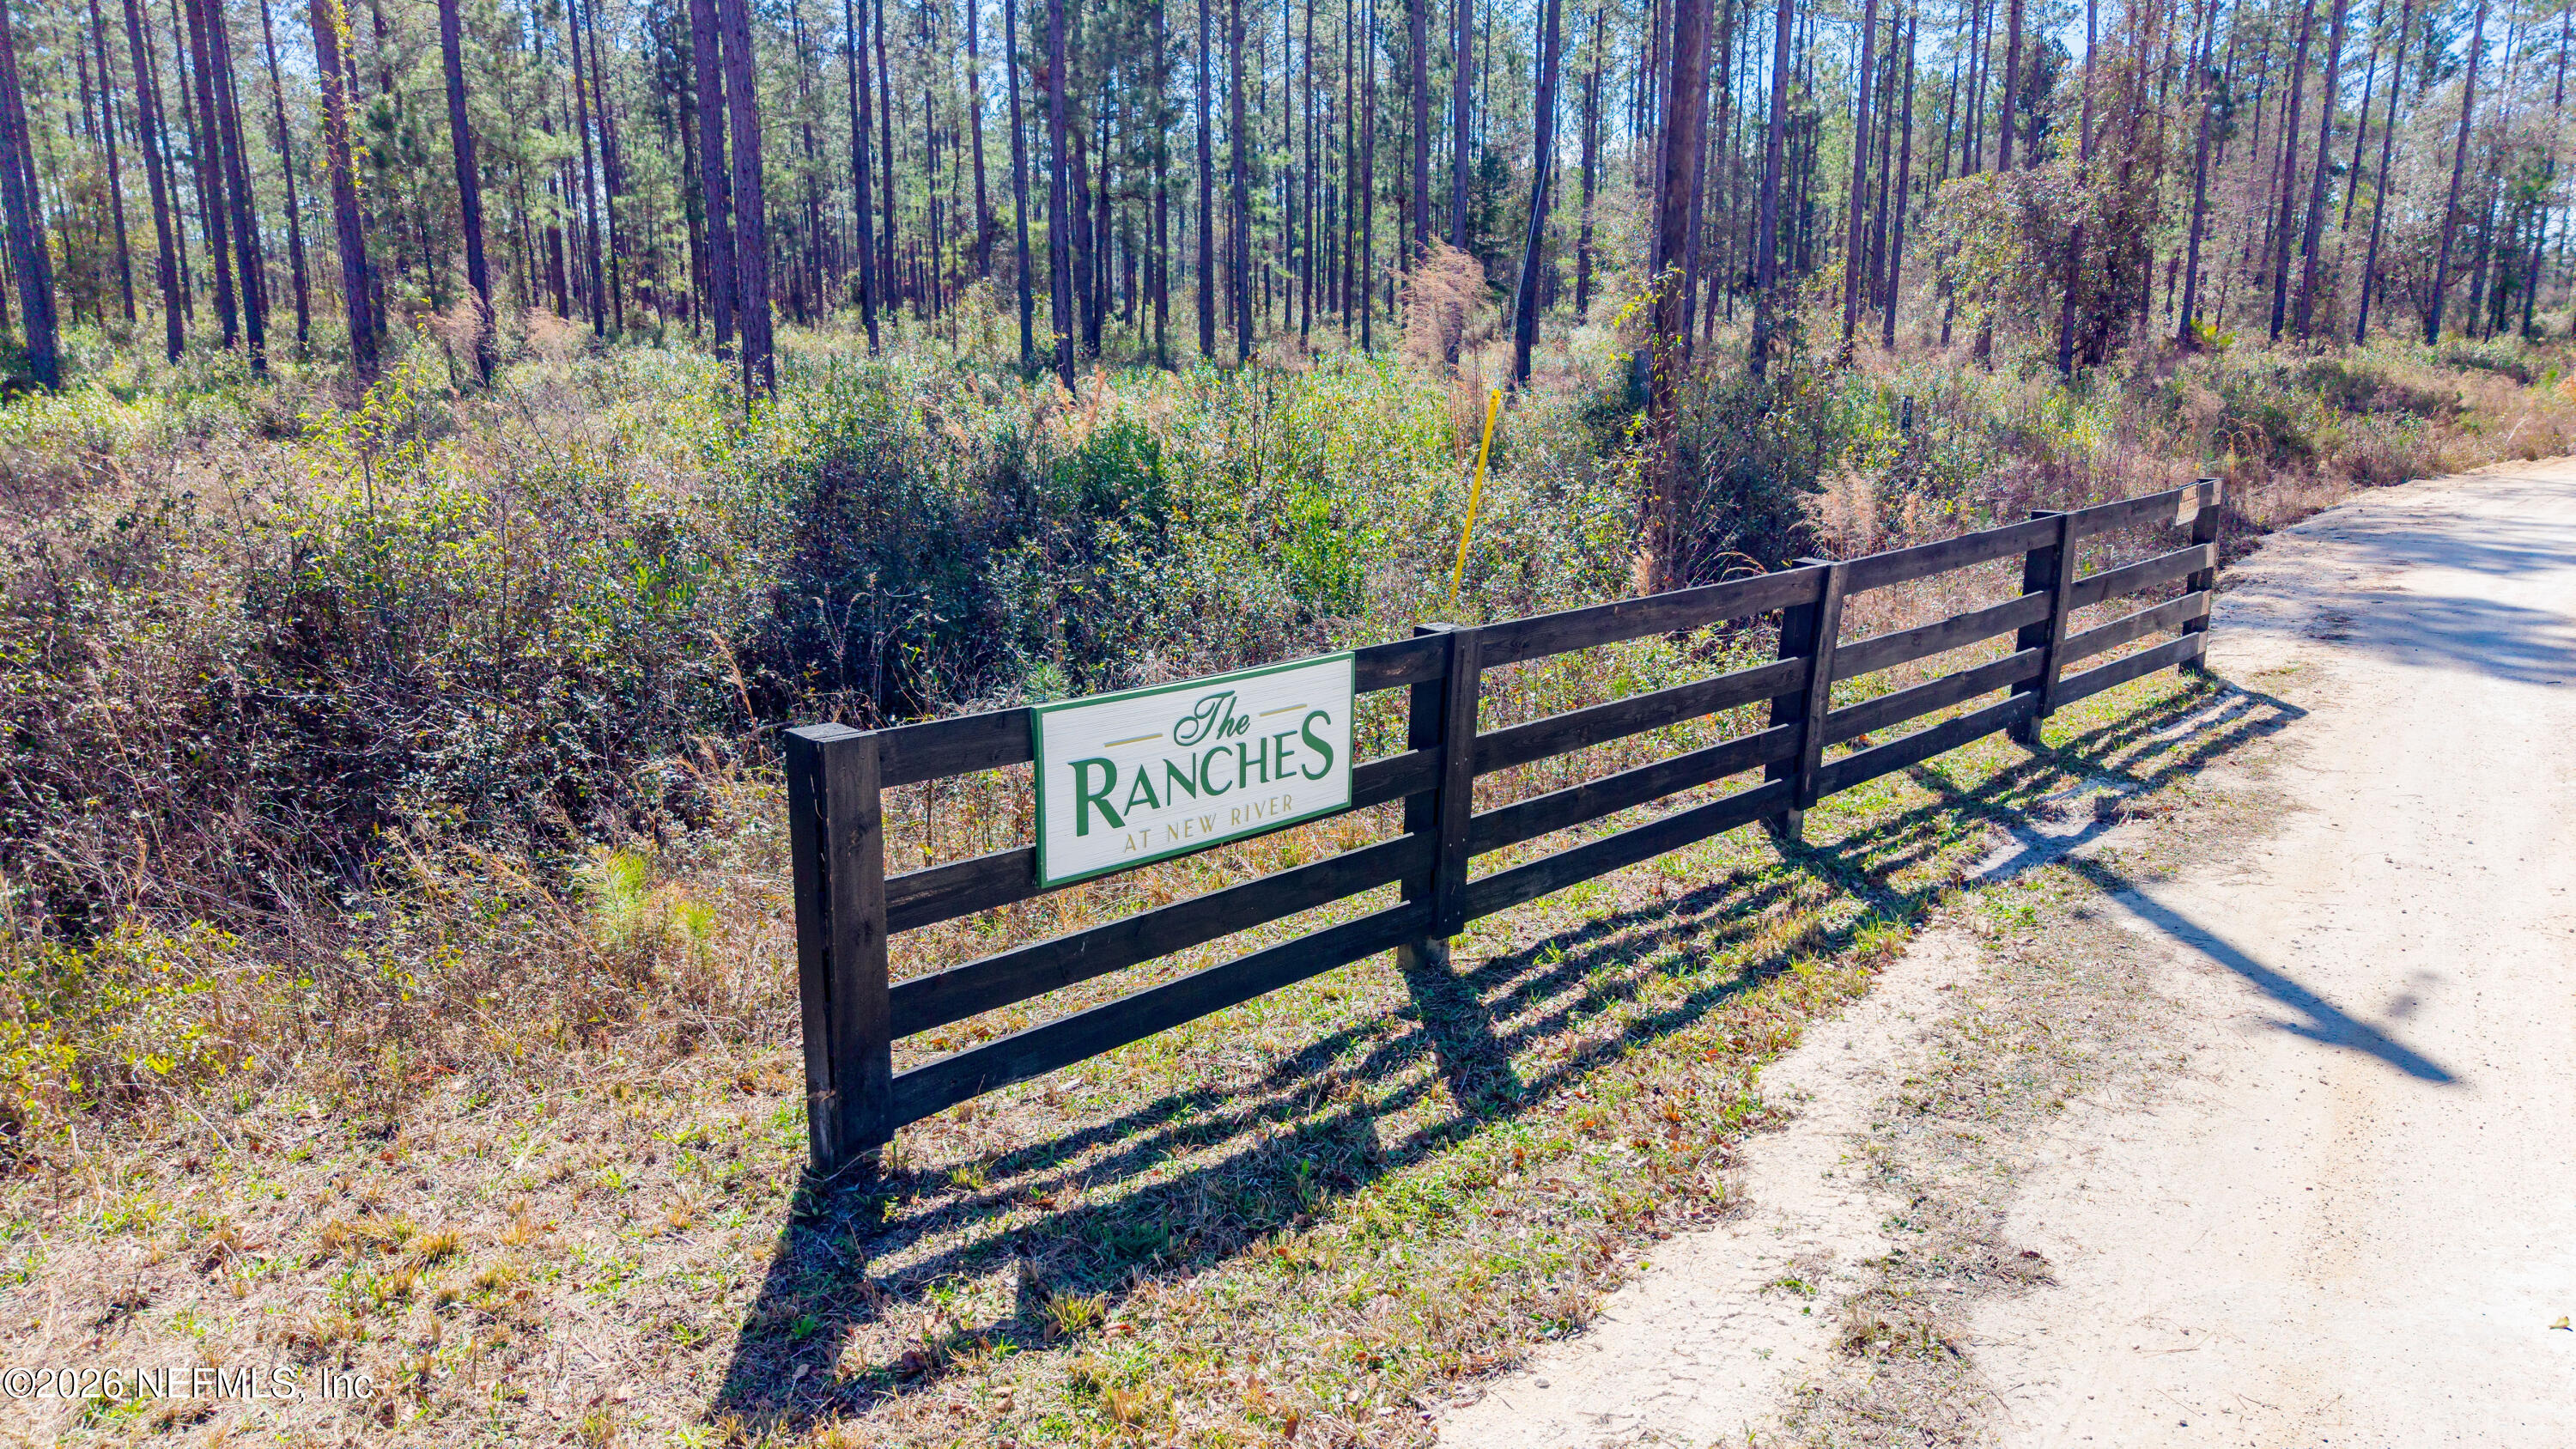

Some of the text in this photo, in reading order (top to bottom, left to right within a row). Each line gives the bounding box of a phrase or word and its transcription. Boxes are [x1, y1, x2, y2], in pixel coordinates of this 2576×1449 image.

[1173, 690, 1250, 746] The
[1067, 709, 1334, 837] RANCHES
[1123, 794, 1293, 854] AT NEW RIVER
